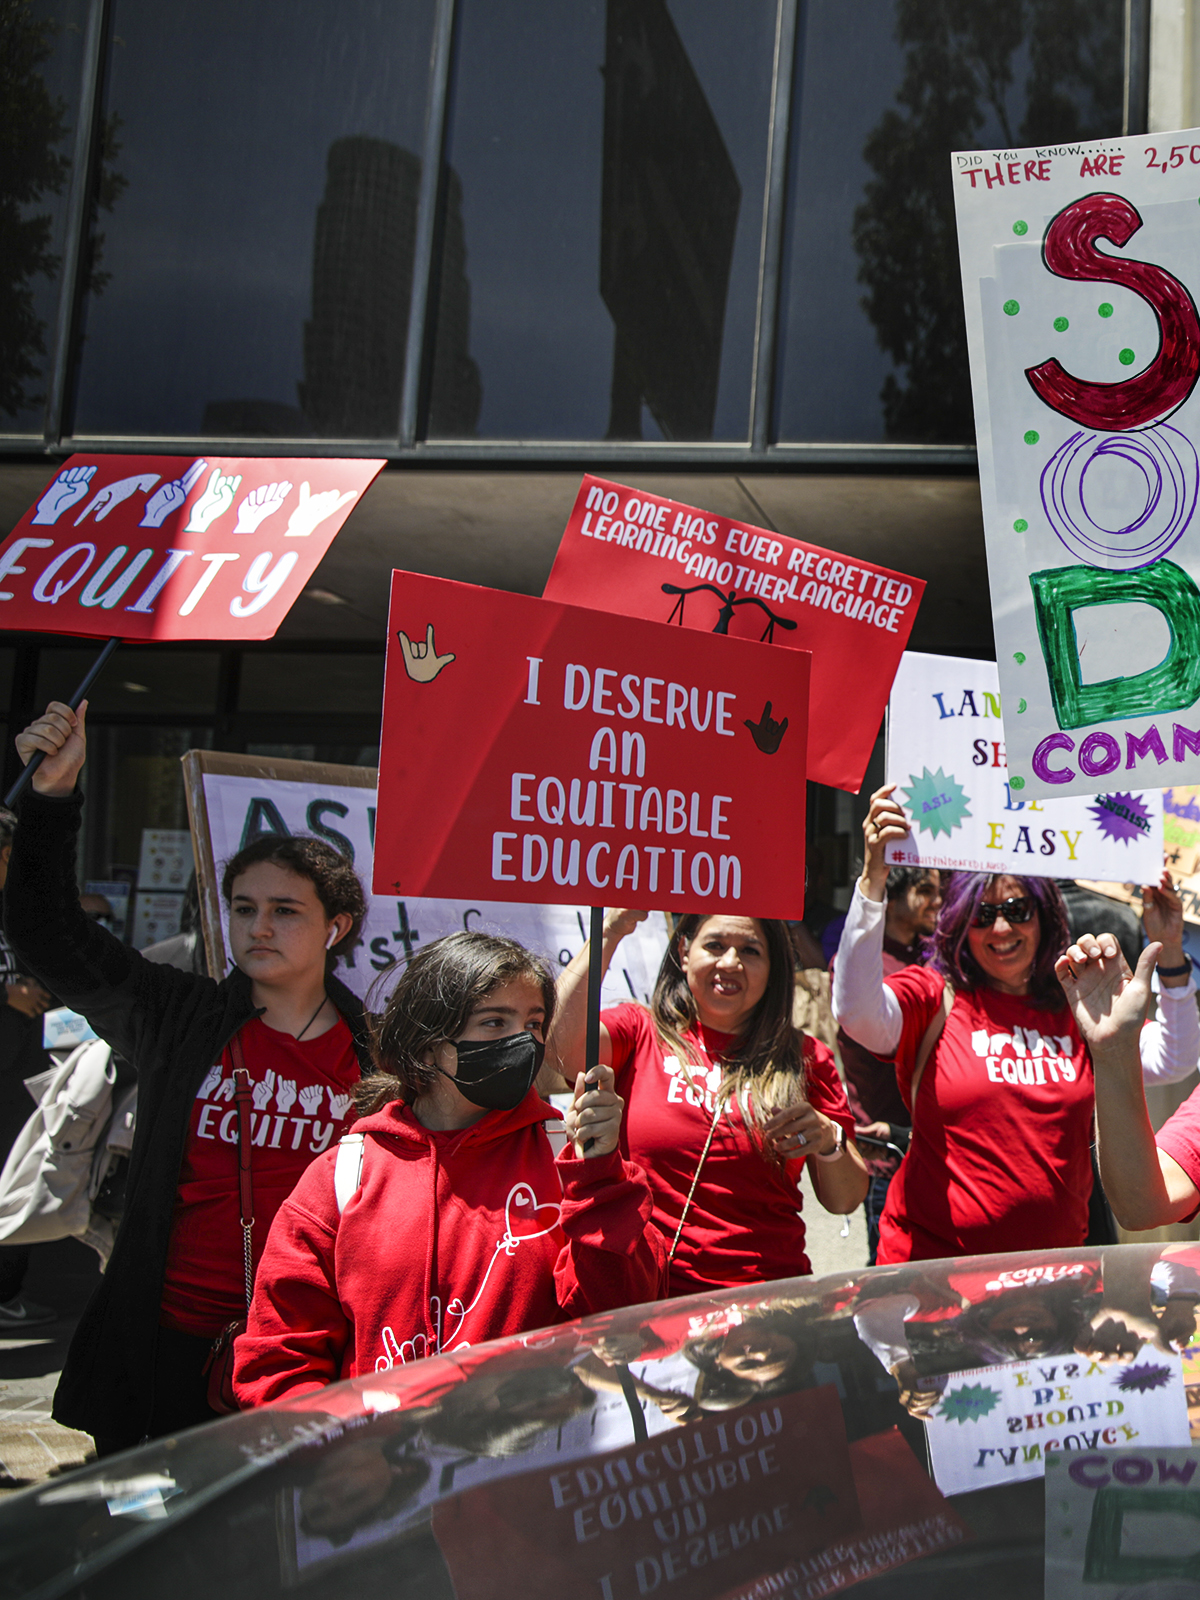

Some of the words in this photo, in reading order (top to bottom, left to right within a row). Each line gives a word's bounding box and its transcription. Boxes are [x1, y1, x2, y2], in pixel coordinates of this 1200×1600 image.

[956, 155, 983, 169] DID
[961, 159, 1053, 189] THERE
[1079, 154, 1126, 178] ARE
[0, 537, 299, 618] EQUITY
[580, 511, 693, 565] LEARNING
[684, 552, 789, 604] ANOTHER
[786, 574, 905, 634] LANGUAGE
[585, 485, 620, 516] NO
[623, 497, 672, 532] ONE
[671, 511, 719, 545] HAS
[724, 528, 784, 567] EVER
[786, 546, 913, 609] REGRETTED
[523, 656, 544, 706] I
[563, 663, 737, 737] DESERVE
[588, 725, 647, 779] AN
[236, 796, 376, 866] AS
[510, 772, 733, 841] EQUITABLE
[921, 792, 953, 814] ASL
[491, 831, 742, 900] EDUCATION
[986, 822, 1084, 861] EASY
[985, 1056, 1077, 1085] EQUITY
[196, 1103, 335, 1154] EQUITY
